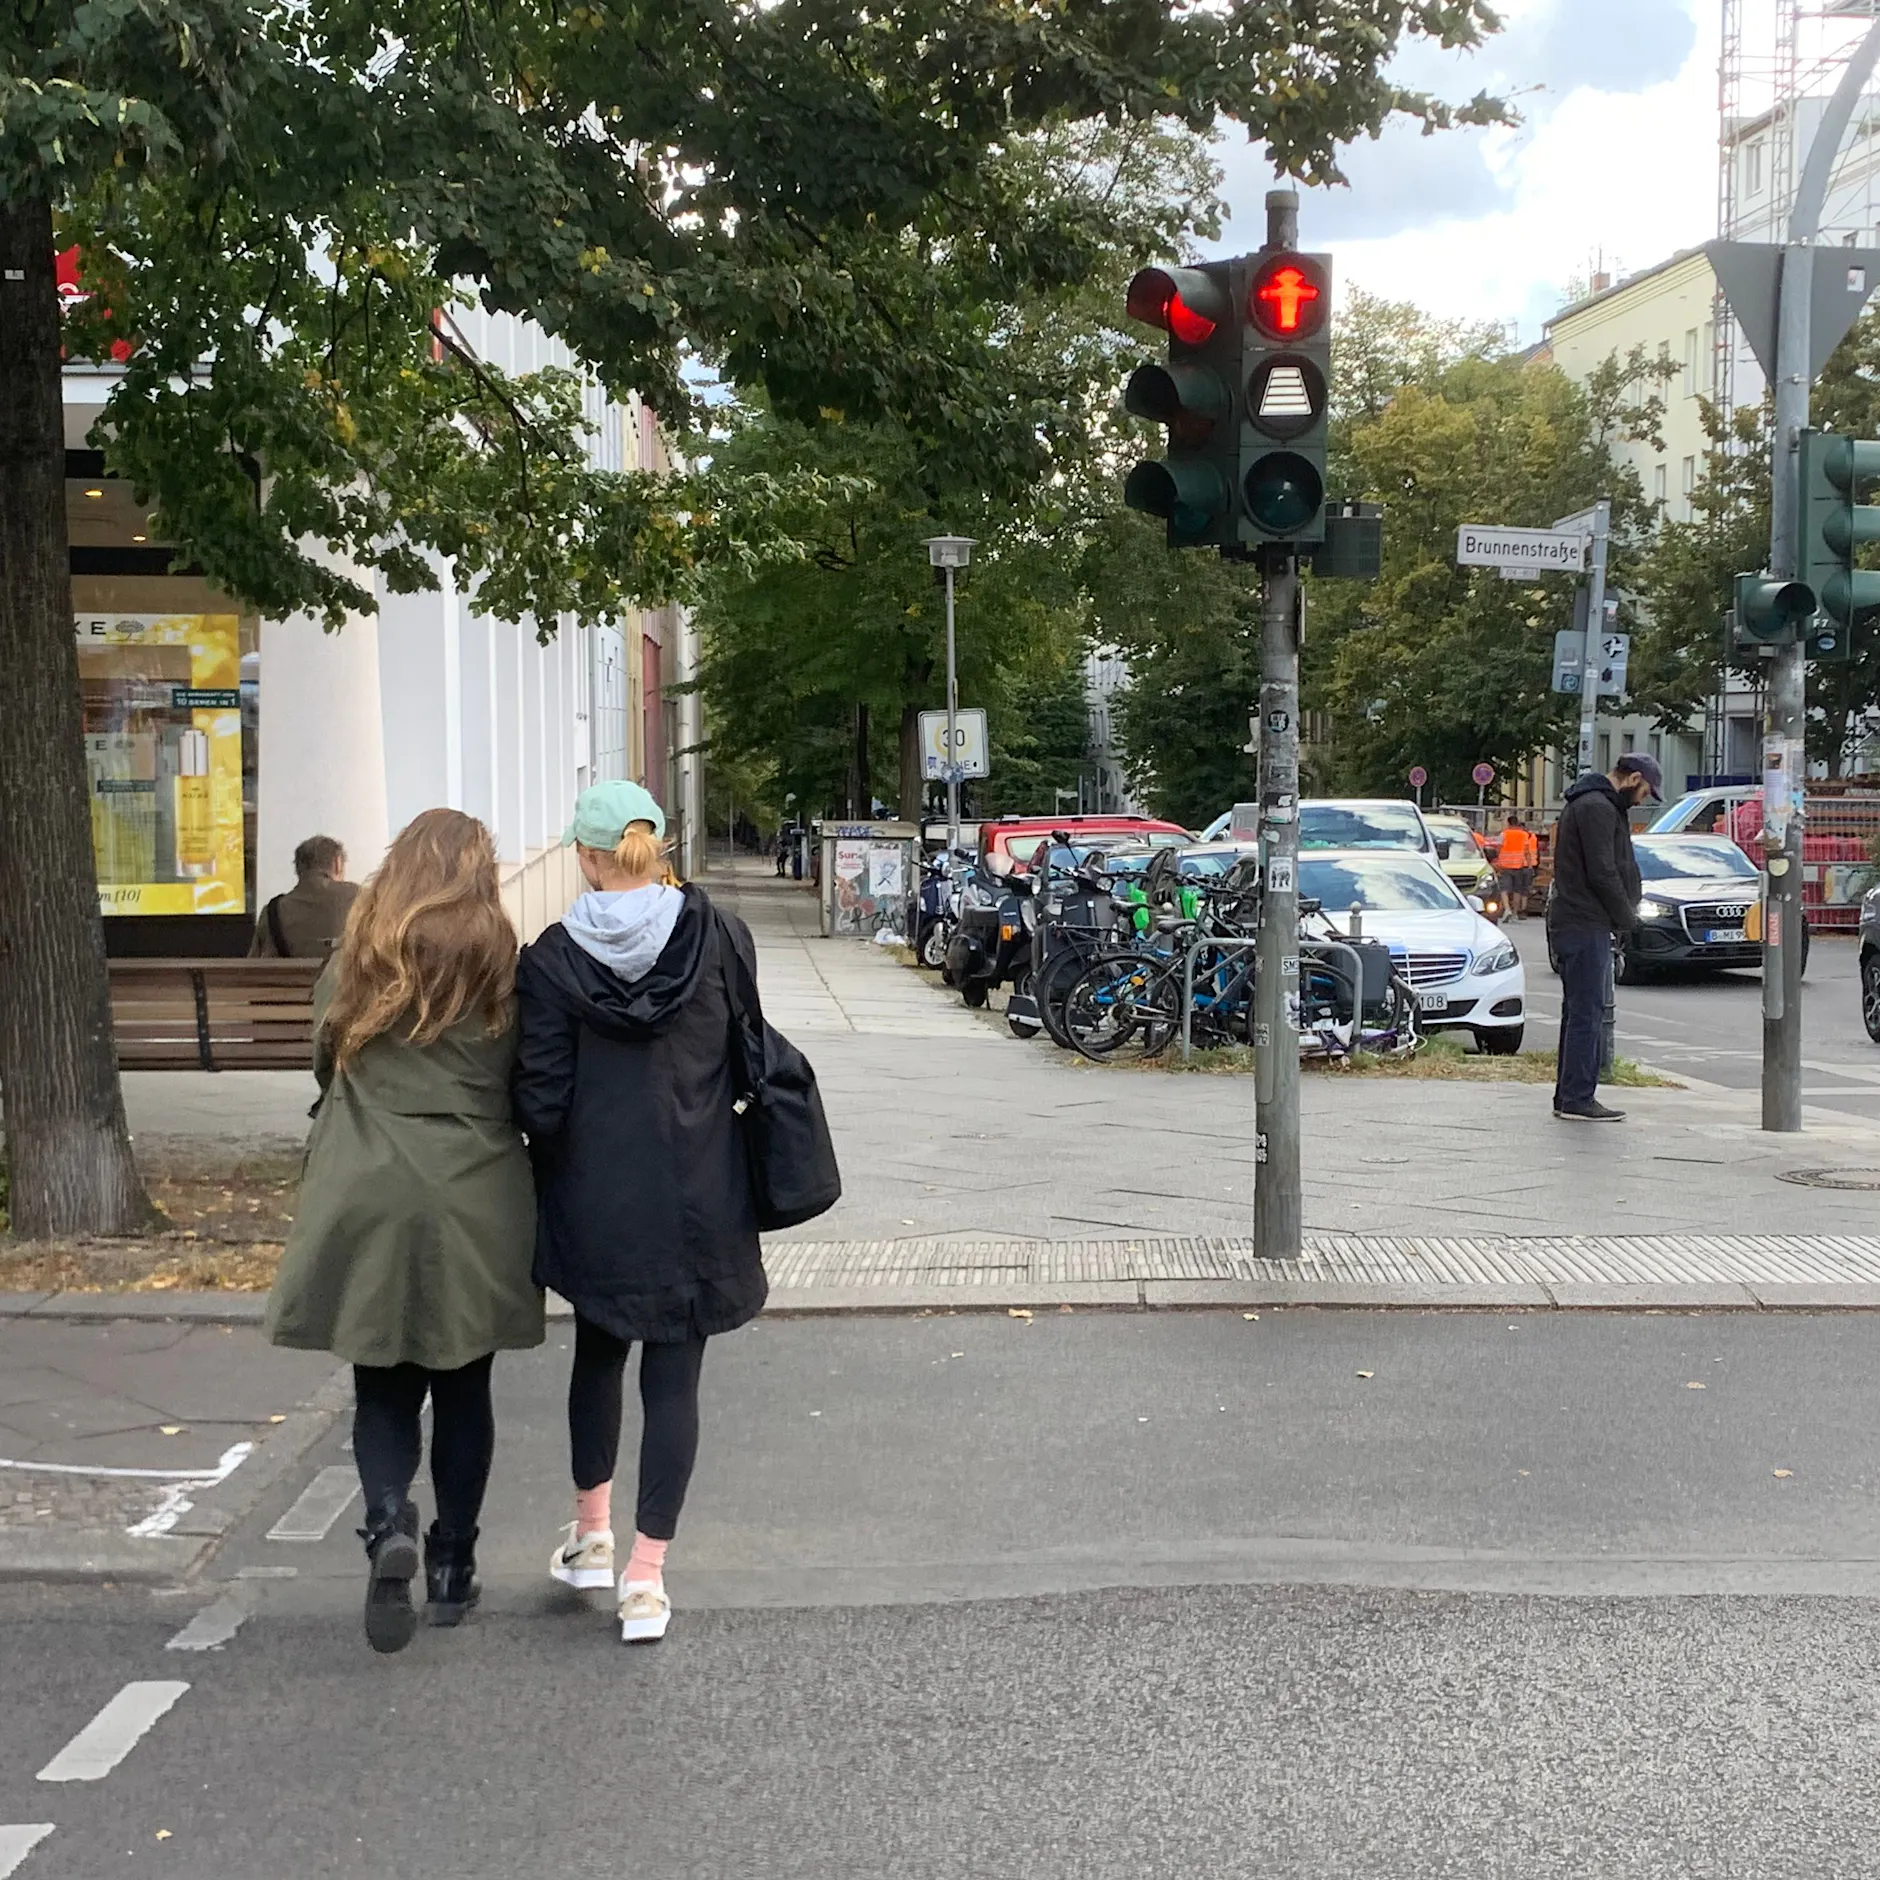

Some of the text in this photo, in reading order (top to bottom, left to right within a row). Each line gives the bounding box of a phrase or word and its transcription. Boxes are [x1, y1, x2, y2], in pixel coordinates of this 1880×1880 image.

[1466, 536, 1578, 563] Brunnenstraße
[942, 728, 965, 747] 30
[940, 760, 971, 771] ZNE
[1420, 995, 1444, 1009] 108
